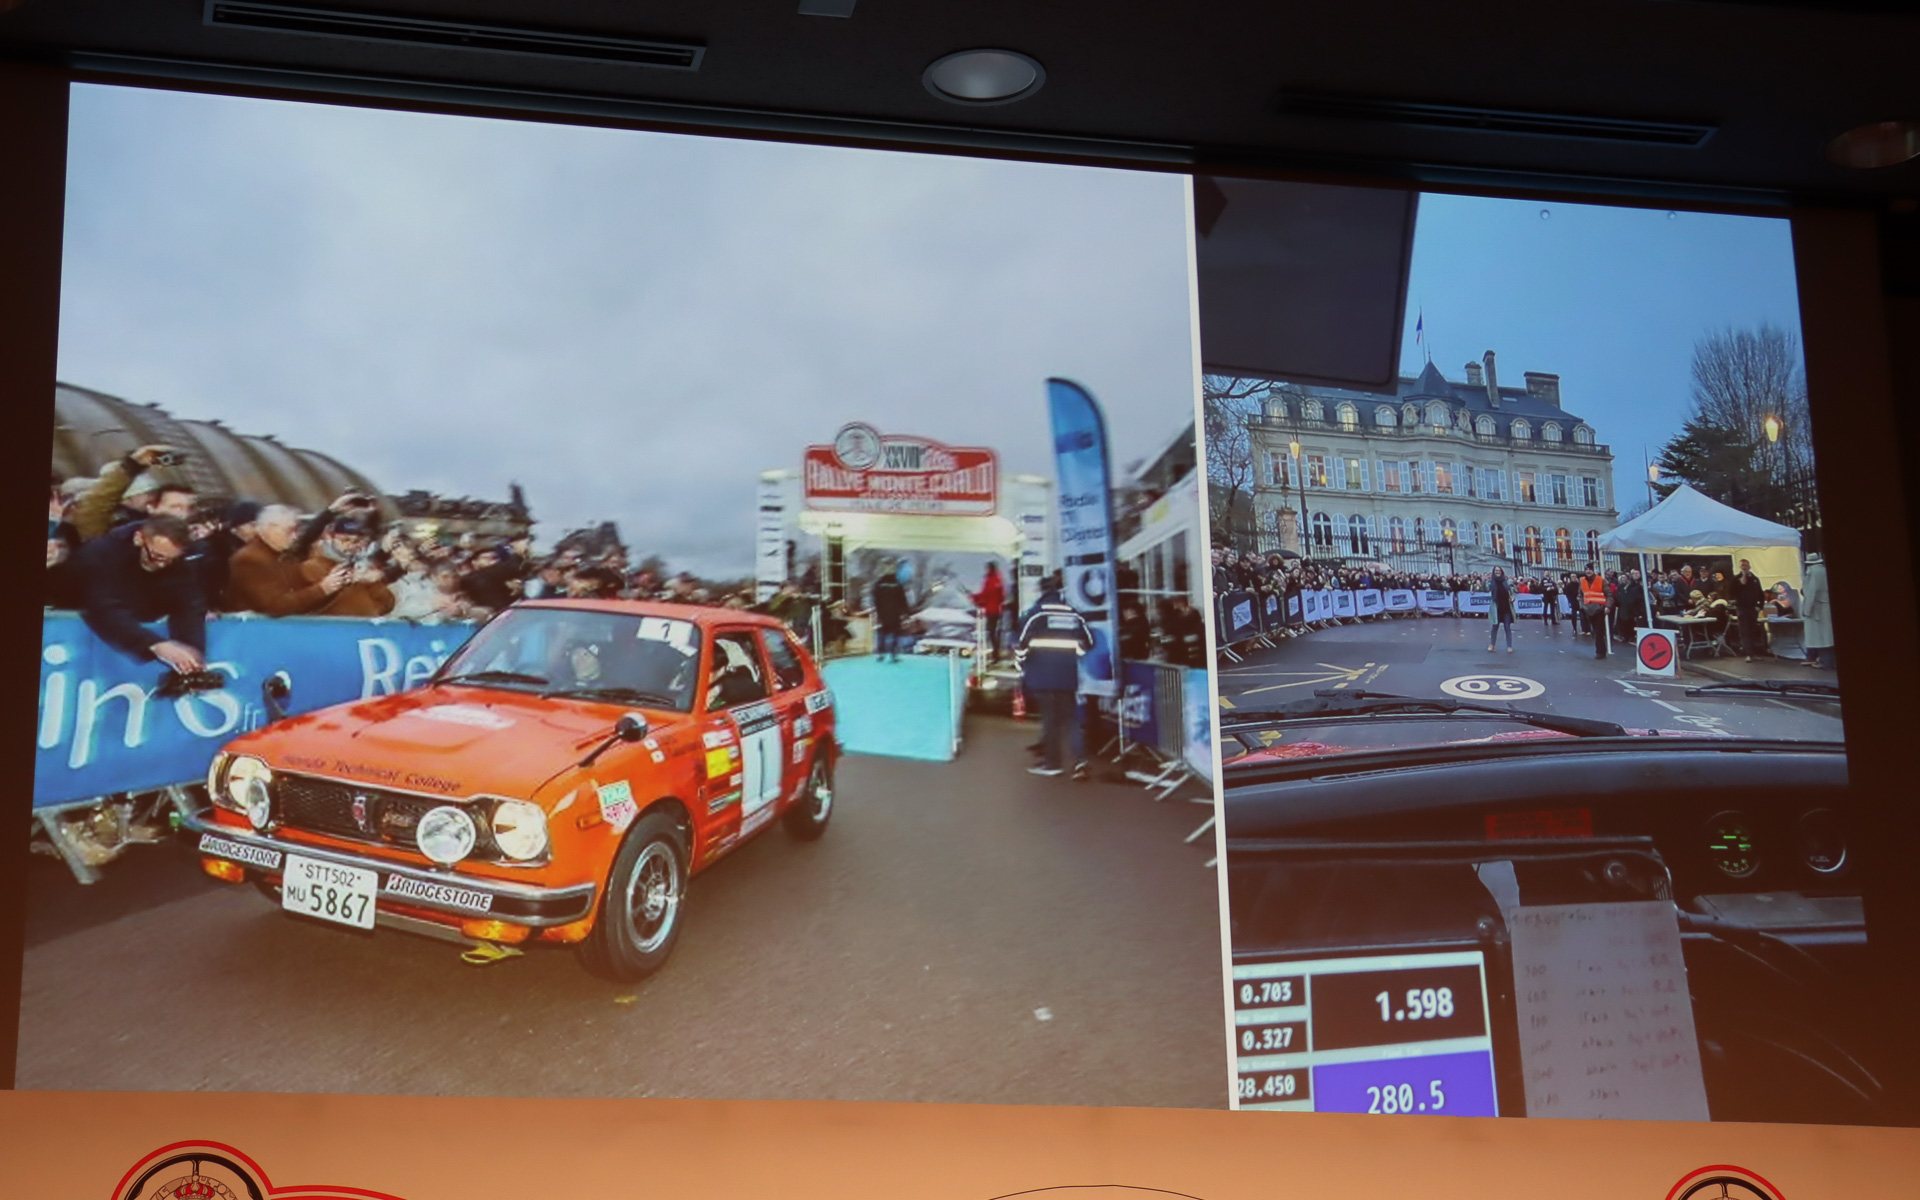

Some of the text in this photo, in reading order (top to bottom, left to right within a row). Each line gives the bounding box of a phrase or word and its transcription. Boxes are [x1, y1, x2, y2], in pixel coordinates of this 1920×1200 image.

[1460, 679, 1523, 692] 30
[286, 884, 369, 923] MU 5867
[389, 873, 491, 909] BRIDGESTONE
[1241, 981, 1293, 1004] 0.703
[1375, 987, 1454, 1021] 1.598
[1242, 1027, 1293, 1051] 0.327
[1367, 1080, 1445, 1114] 280.5
